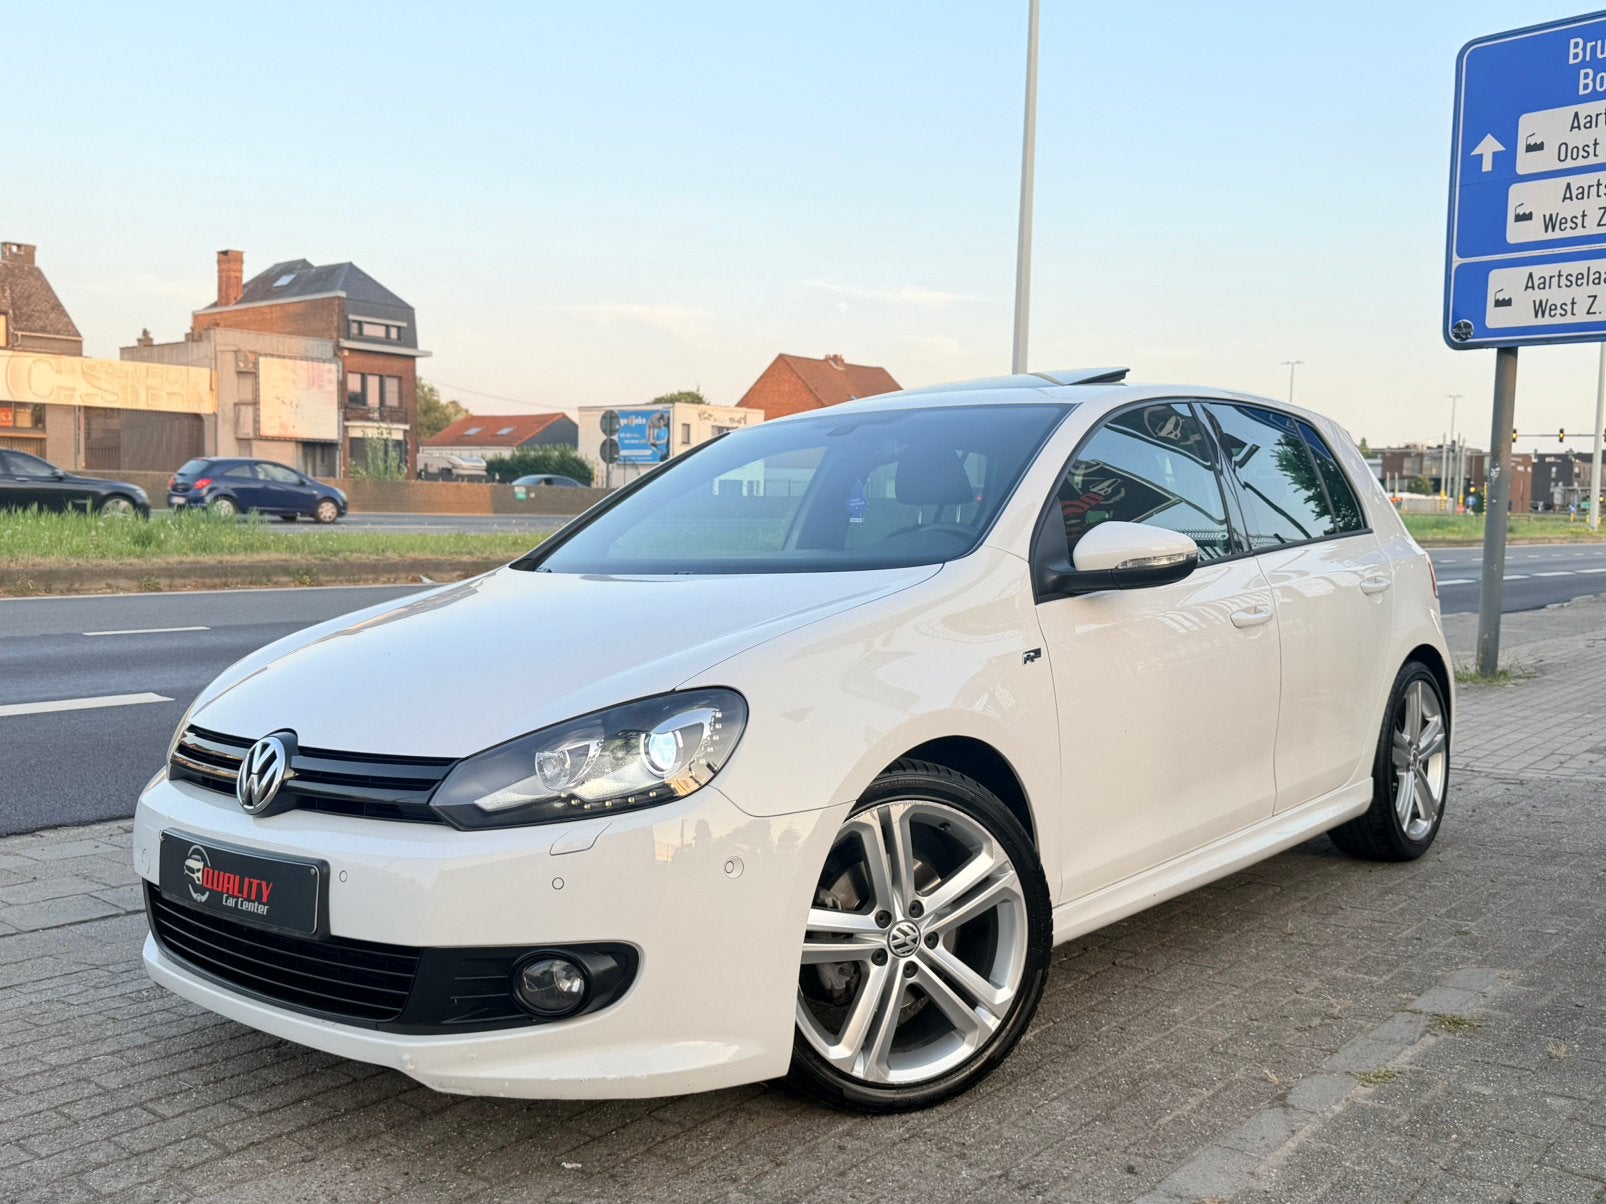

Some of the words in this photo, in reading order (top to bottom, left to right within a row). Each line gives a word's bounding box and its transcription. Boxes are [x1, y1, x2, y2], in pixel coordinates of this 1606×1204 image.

[1568, 37, 1606, 65] Bru
[1578, 68, 1606, 96] Bo
[1557, 138, 1600, 162] Oost
[1562, 178, 1606, 203] Aart
[1543, 209, 1588, 233] West
[1597, 206, 1606, 228] Z
[1532, 297, 1578, 319] West
[1586, 295, 1602, 315] Z.
[203, 866, 273, 904] QUALITY
[222, 893, 237, 908] Car
[237, 897, 270, 916] Center
